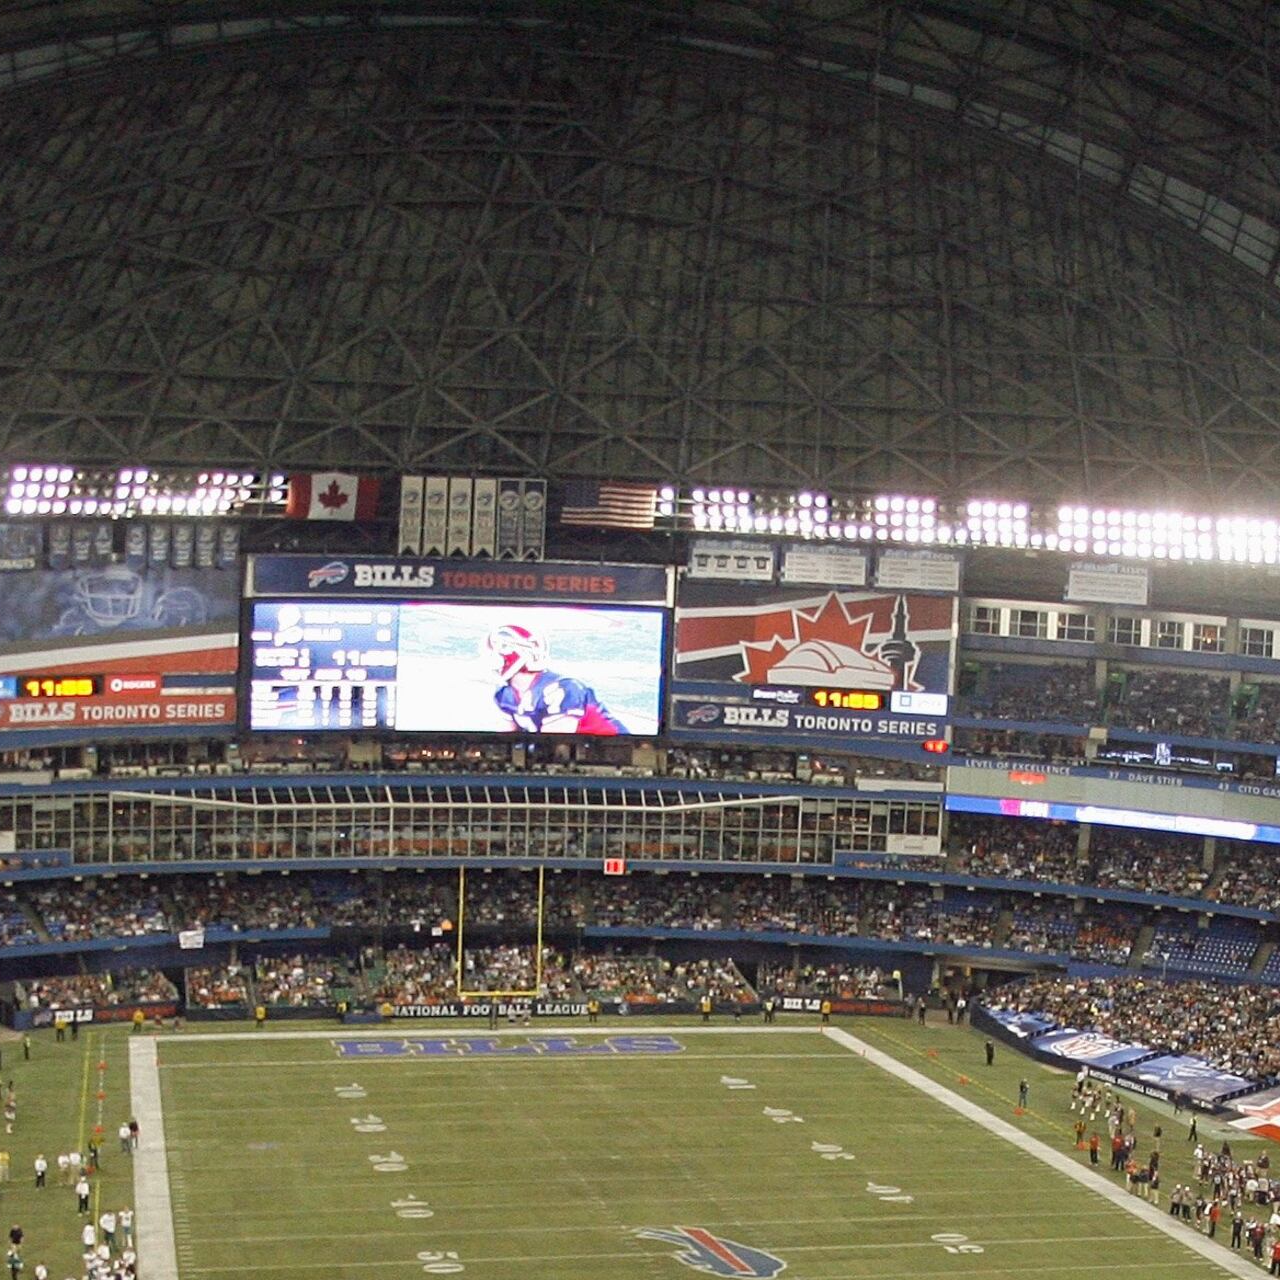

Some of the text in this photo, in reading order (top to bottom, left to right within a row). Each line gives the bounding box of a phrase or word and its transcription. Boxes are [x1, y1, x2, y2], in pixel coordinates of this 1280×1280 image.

[354, 565, 616, 594] BILLS TORONTO SERIES
[122, 680, 156, 690] ROGERS
[9, 702, 225, 722] BILLS TORONTO SERIES
[723, 707, 937, 736] BILLS TORONTO SERIES
[965, 760, 1070, 776] LEVEL OF EXCELLENCE
[1128, 773, 1154, 784] DAVE
[1157, 775, 1183, 787] STIEB
[1238, 784, 1260, 795] CITO
[463, 1004, 531, 1017] FOOBALL
[537, 1003, 589, 1016] LEAGUE
[1089, 1068, 1116, 1084] NATIONAL
[417, 1250, 465, 1274] 50
